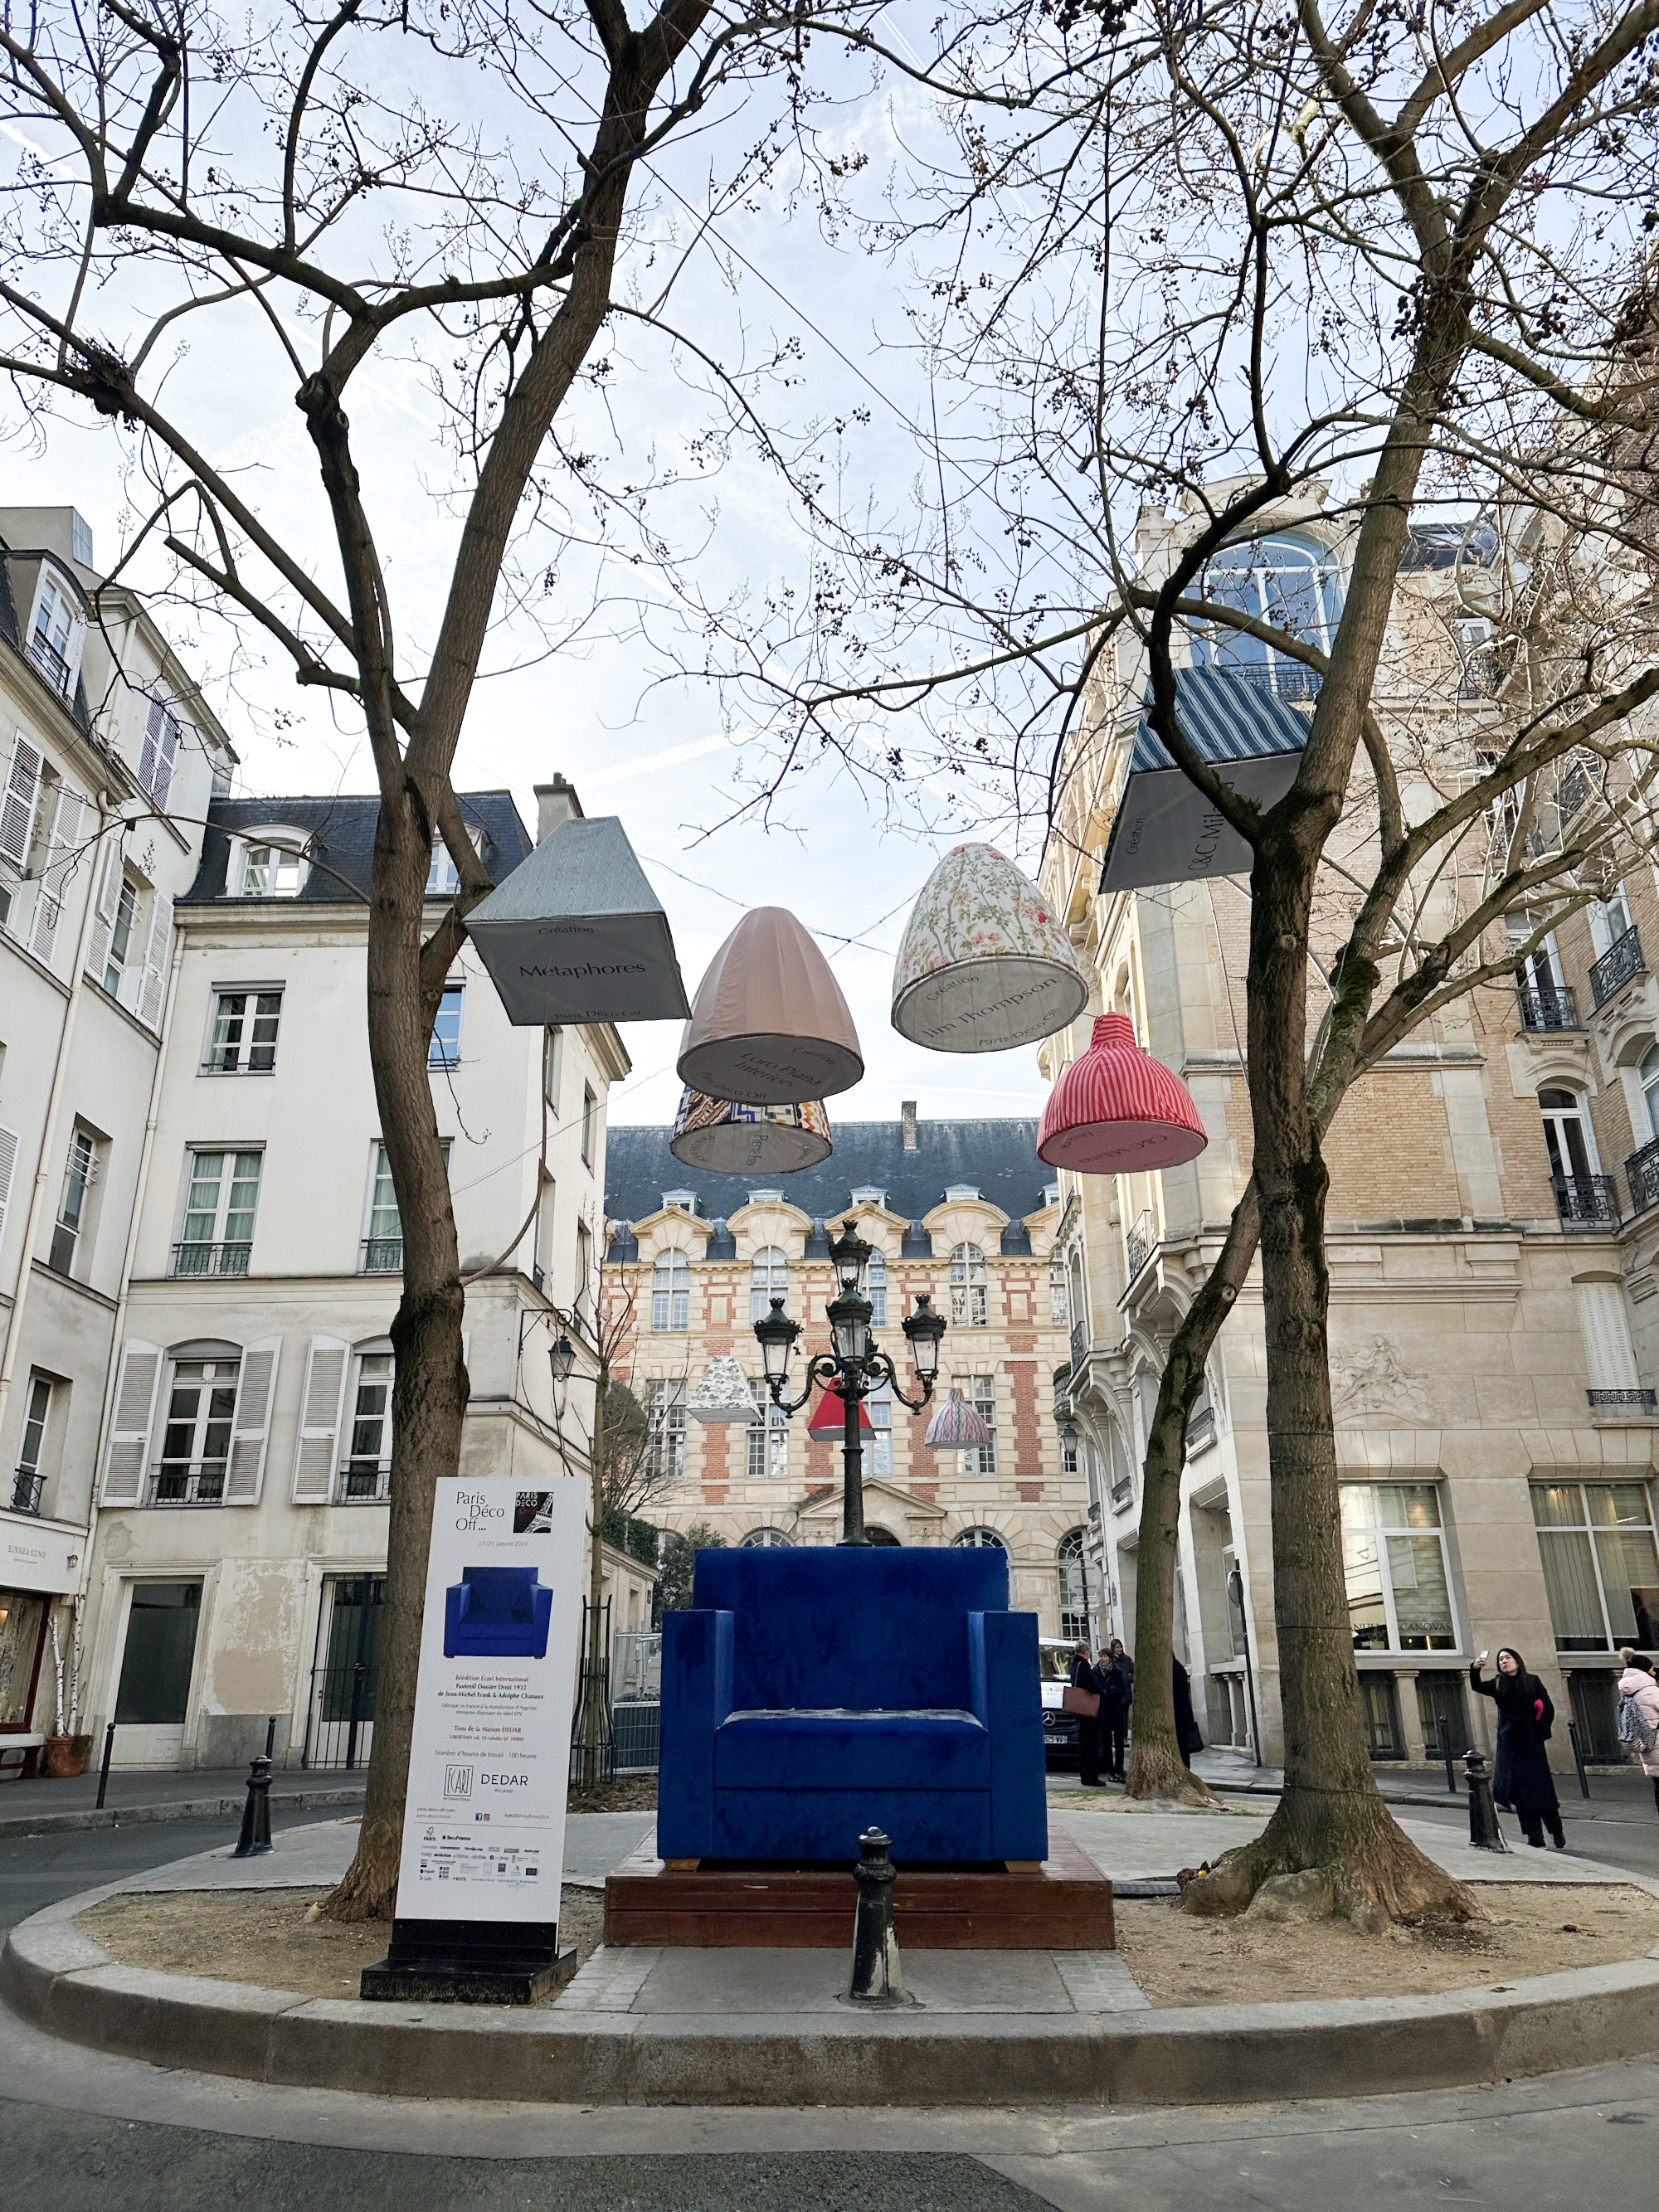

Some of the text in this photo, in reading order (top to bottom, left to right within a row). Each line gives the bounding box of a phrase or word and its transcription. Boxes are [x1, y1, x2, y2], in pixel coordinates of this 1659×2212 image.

[1187, 843, 1217, 871] C&C
[538, 925, 595, 936] Création
[922, 977, 1058, 1038] Jim Thompson
[733, 1062, 797, 1088] Interiors
[740, 1052, 823, 1087] Loro Piana
[750, 1135, 769, 1156] Pierre
[456, 1491, 485, 1505] Paris
[469, 1504, 505, 1518] Déco
[1399, 1621, 1452, 1633] CANOVAS
[498, 1692, 520, 1700] Adolphe
[446, 1767, 471, 1794] ECART
[481, 1773, 528, 1787] DEDAR
